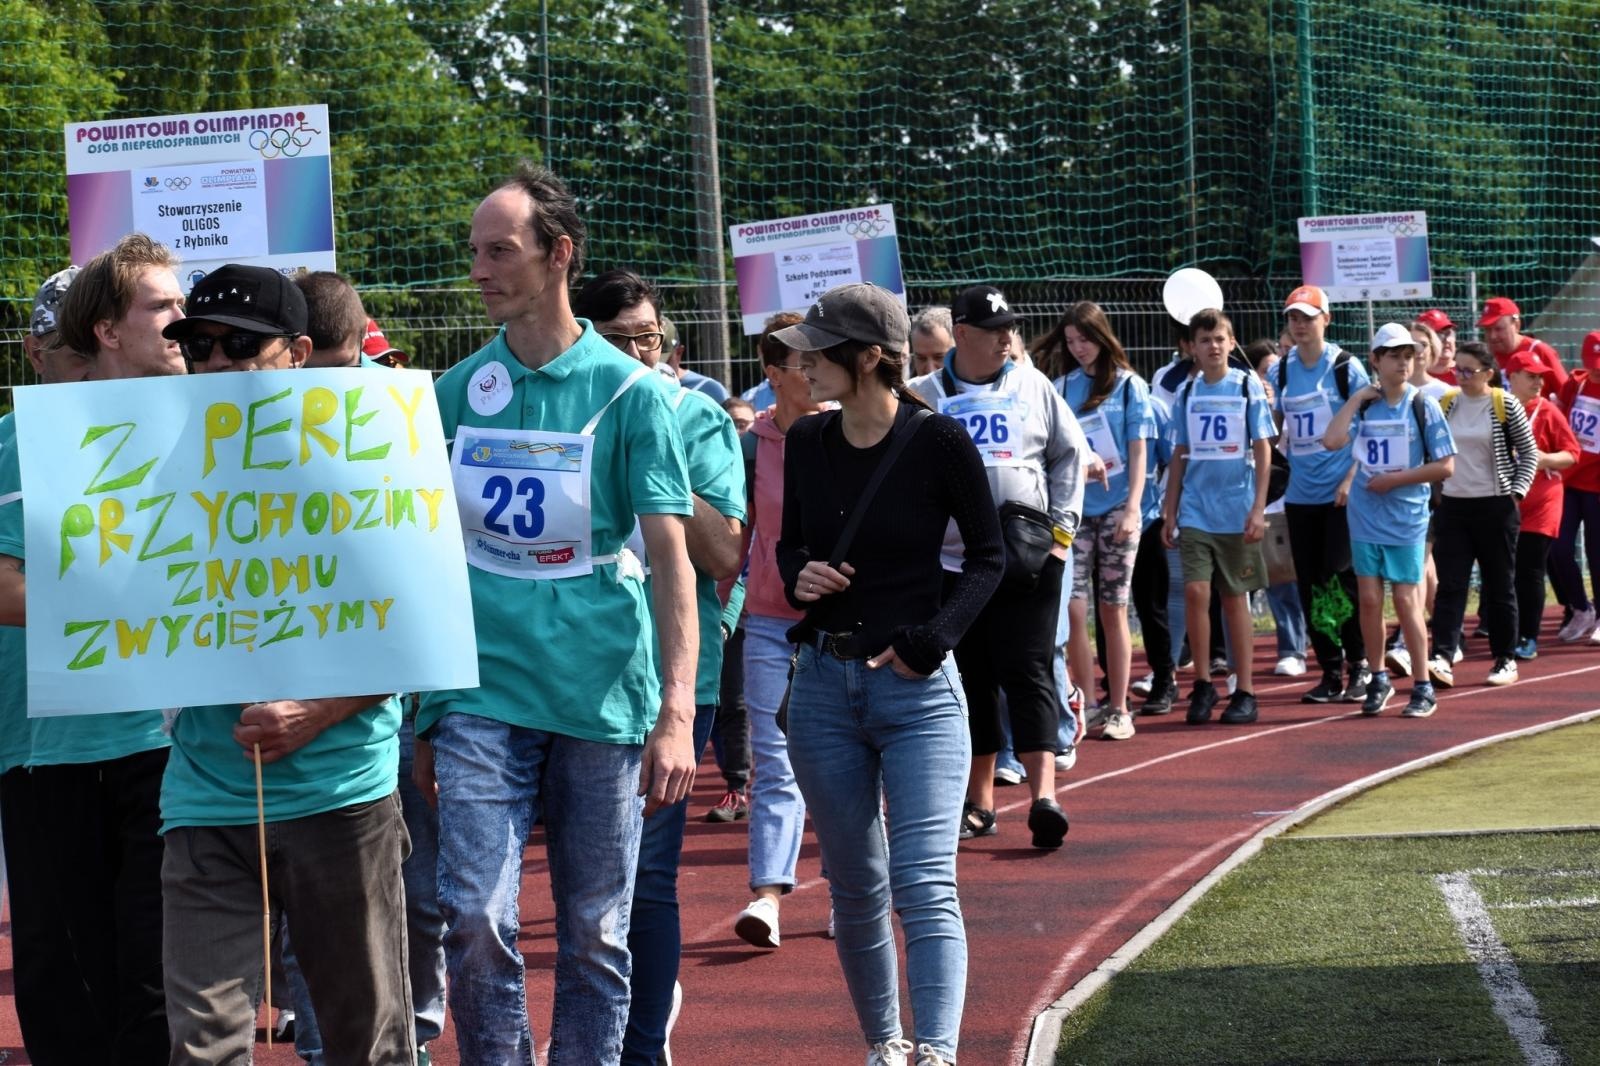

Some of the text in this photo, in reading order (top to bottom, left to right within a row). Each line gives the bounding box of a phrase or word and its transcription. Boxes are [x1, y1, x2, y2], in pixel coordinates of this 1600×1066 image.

[76, 112, 295, 142] POWIATOWA OLIMPIADA
[87, 134, 240, 154] OSÓB NIEPEŁNOSPRAWNYCH
[158, 200, 242, 218] Stowarzyszenie
[182, 217, 220, 231] OLIGOS
[738, 210, 874, 238] POWIATOWA OLIMPIADA
[176, 234, 228, 250] z Rybnika
[785, 267, 852, 282] Szkoła Podstawowa
[958, 414, 1008, 444] 26
[1200, 414, 1227, 441] 76
[1293, 412, 1314, 438] 77
[1572, 410, 1598, 436] 132
[80, 422, 159, 496] Z
[1367, 439, 1390, 465] 81
[482, 475, 545, 539] 23
[540, 553, 570, 562] EFEKT
